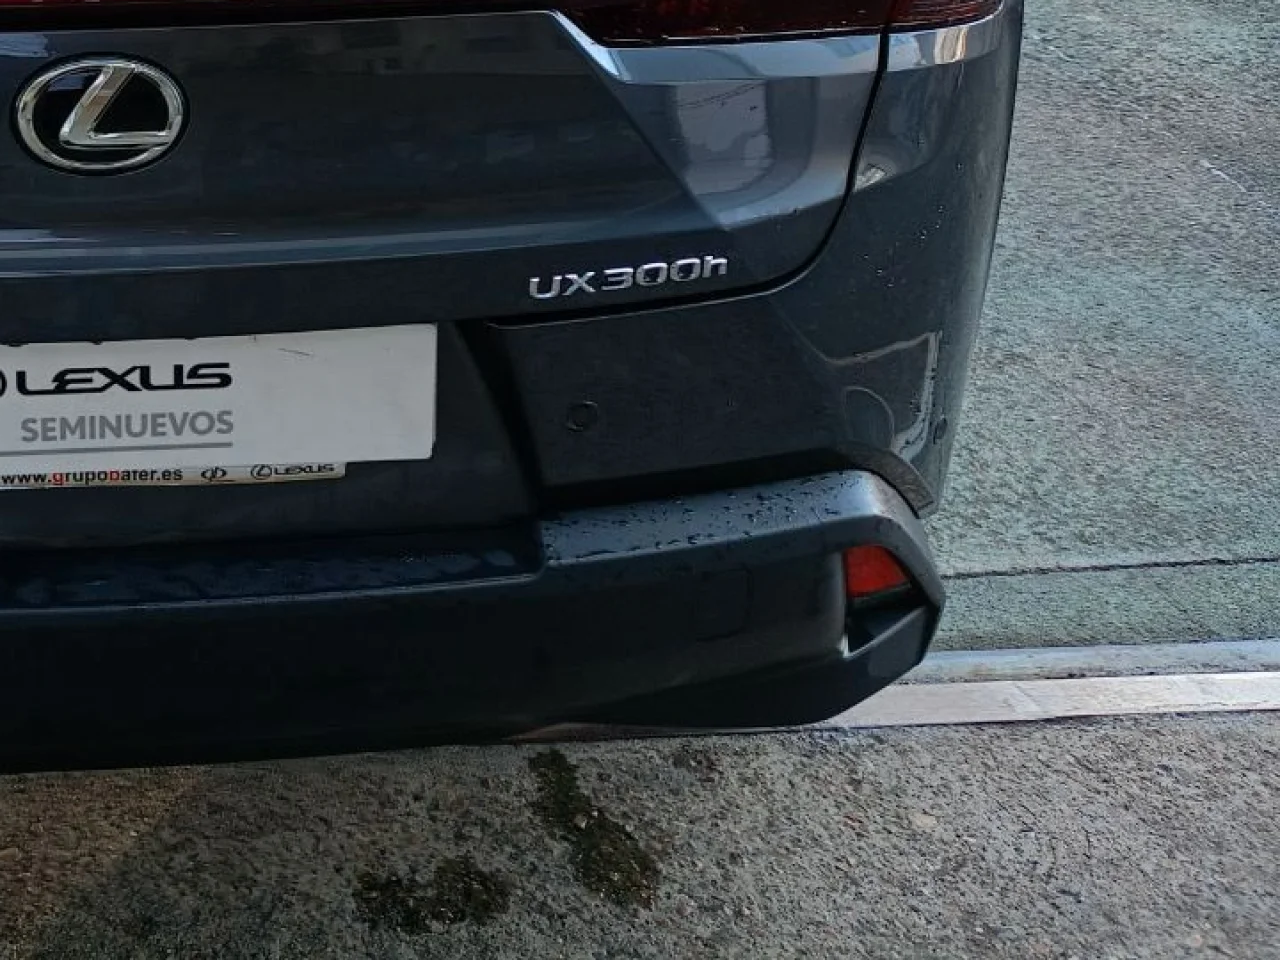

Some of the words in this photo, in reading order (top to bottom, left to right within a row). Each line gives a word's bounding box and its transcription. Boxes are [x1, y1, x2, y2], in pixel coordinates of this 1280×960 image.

[529, 271, 596, 300] UX
[600, 255, 728, 291] 300h
[15, 362, 233, 396] LEXUS
[21, 409, 235, 442] SEMINUEVOS
[274, 463, 336, 476] LEXUS
